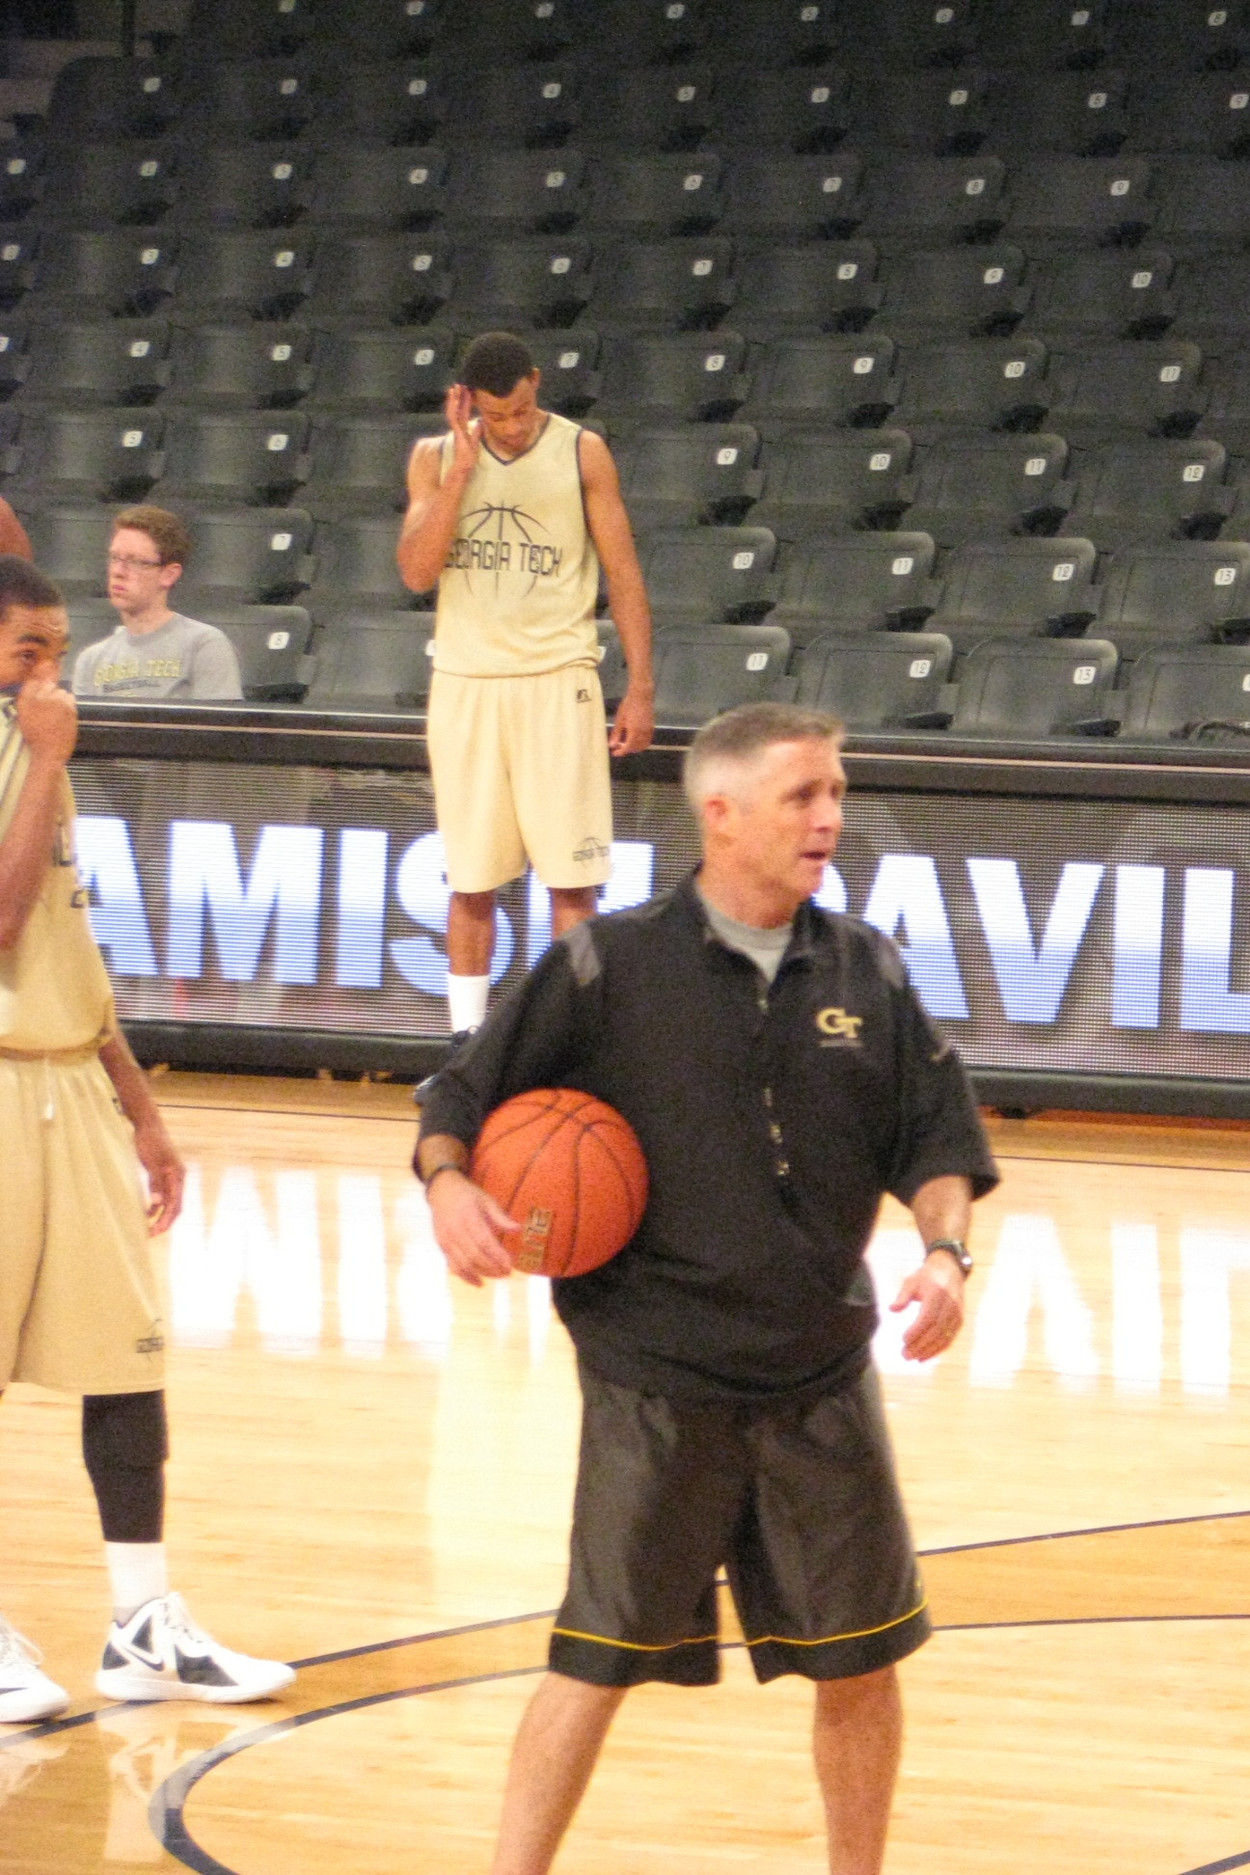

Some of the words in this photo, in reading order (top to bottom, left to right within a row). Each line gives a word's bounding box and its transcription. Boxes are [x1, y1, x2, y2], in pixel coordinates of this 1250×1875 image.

[445, 537, 511, 571] EORGIA
[519, 542, 563, 577] TECH
[816, 1007, 863, 1039] GT
